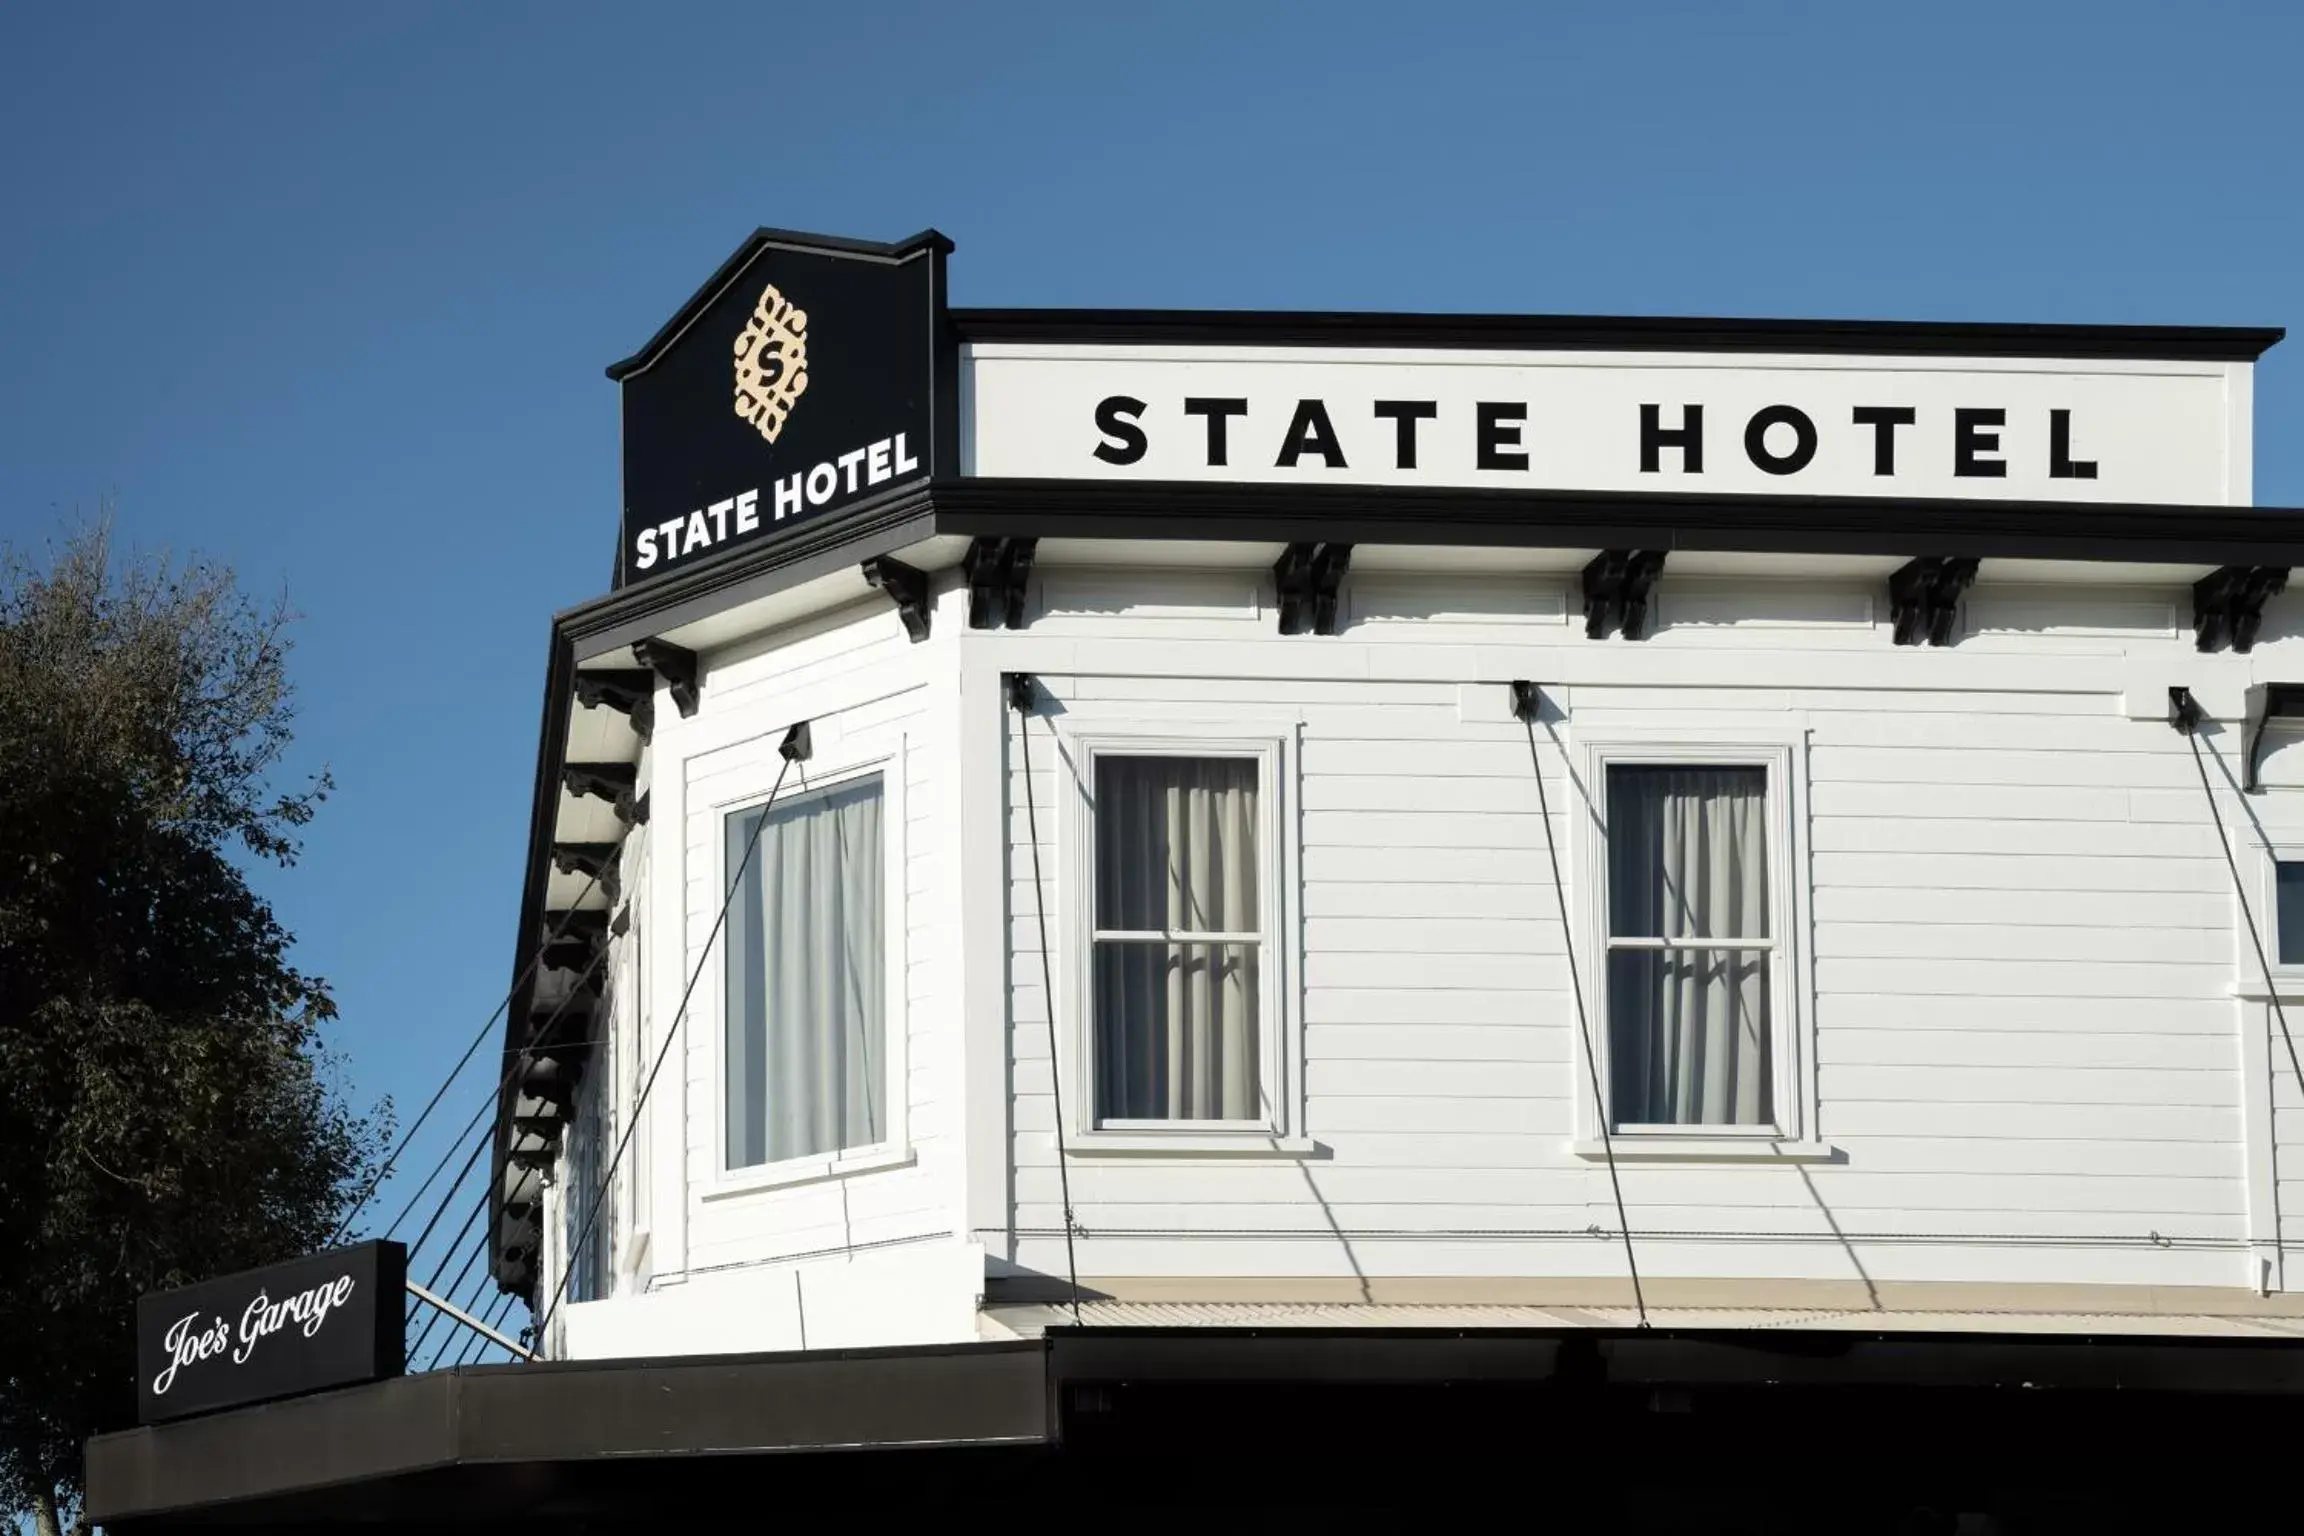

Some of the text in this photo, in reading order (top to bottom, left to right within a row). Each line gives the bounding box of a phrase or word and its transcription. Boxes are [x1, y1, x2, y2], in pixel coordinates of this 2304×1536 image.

[1093, 395, 2098, 480] STATE HOTEL
[635, 432, 919, 570] STATE HOTEL
[152, 1274, 356, 1395] Joe's Garage
